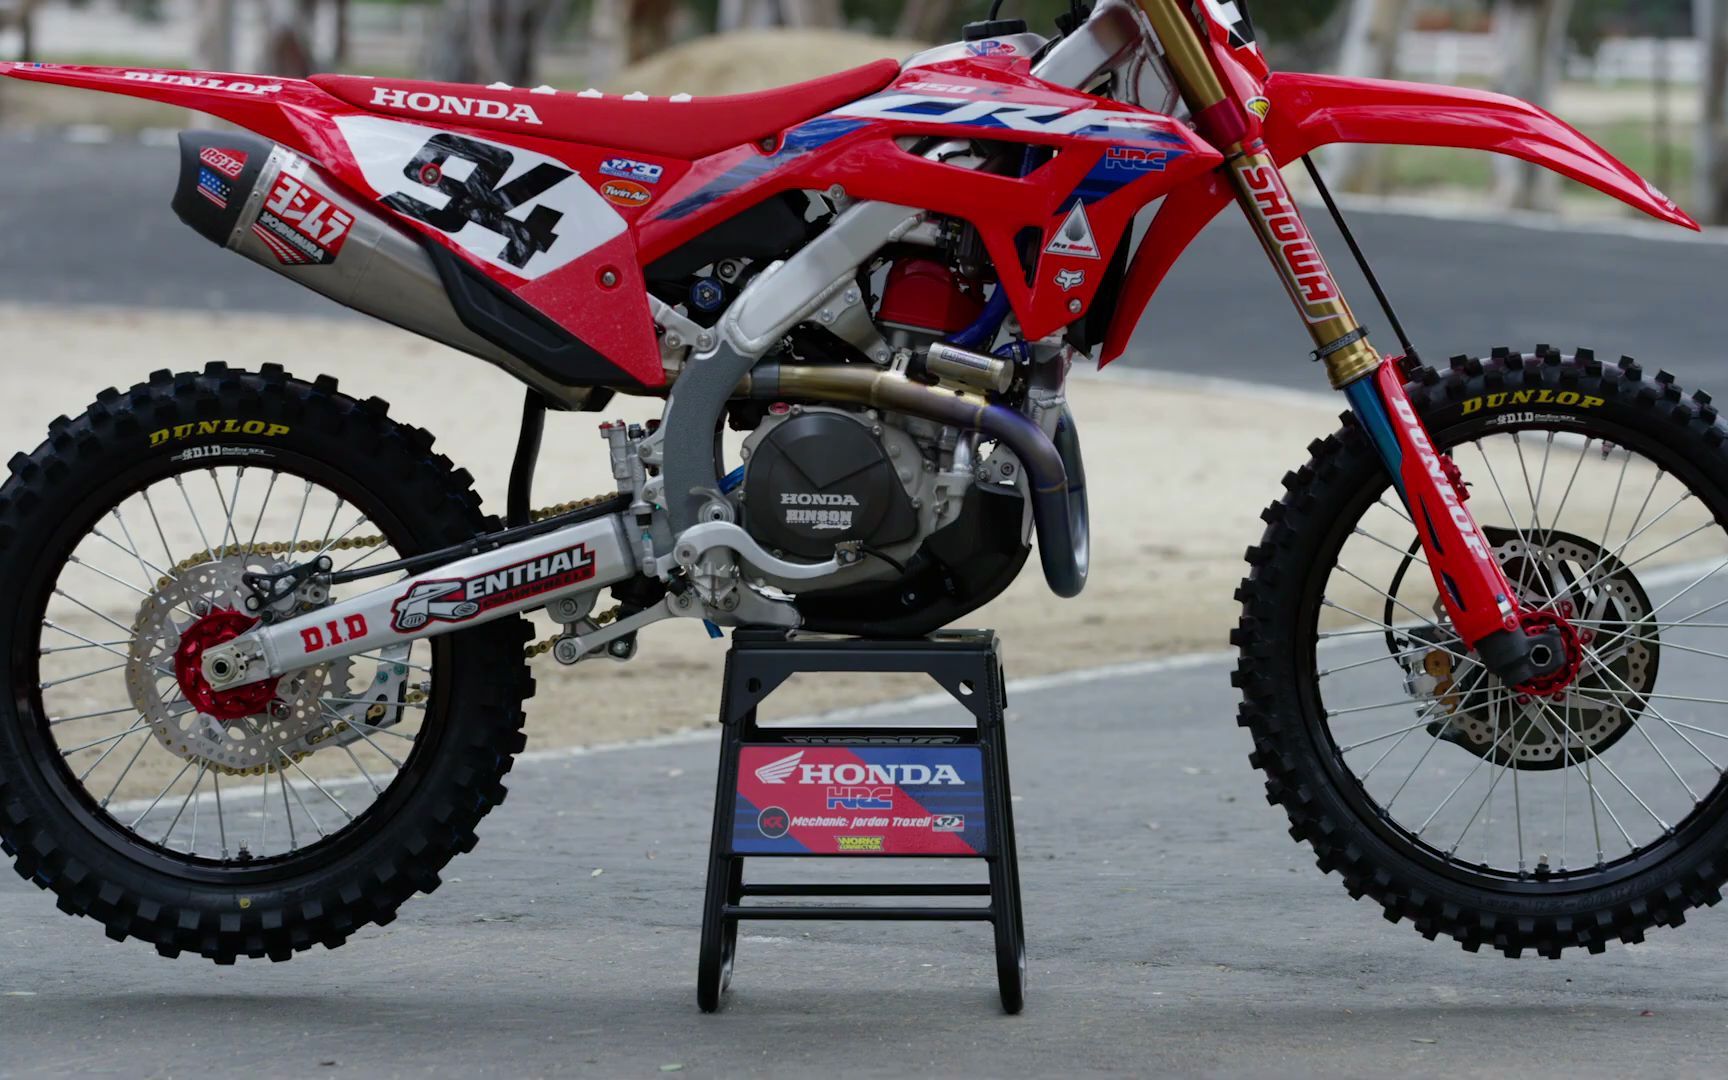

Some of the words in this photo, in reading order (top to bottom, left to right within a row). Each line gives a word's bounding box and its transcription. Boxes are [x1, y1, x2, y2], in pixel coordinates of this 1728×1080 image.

[122, 70, 283, 95] DUNLOP
[369, 86, 543, 125] HONDA
[1105, 145, 1168, 171] HRC
[375, 133, 576, 270] 94
[605, 185, 630, 198] Twin
[630, 191, 650, 201] Air
[265, 175, 353, 247] ヨシムラ
[258, 211, 325, 263] YOSHIMURA
[1238, 166, 1340, 305] SHOWA
[1461, 389, 1606, 416] DUNLOP
[149, 419, 290, 449] DUNLOP
[1391, 397, 1490, 561] DUNLOP
[780, 493, 860, 506] HONDA
[785, 509, 853, 522] HINSON
[300, 613, 368, 653] D.I.D
[799, 764, 965, 785] HONDA
[827, 786, 893, 810] HRC
[790, 815, 849, 827] Mechanic:
[839, 836, 881, 844] WORKS
